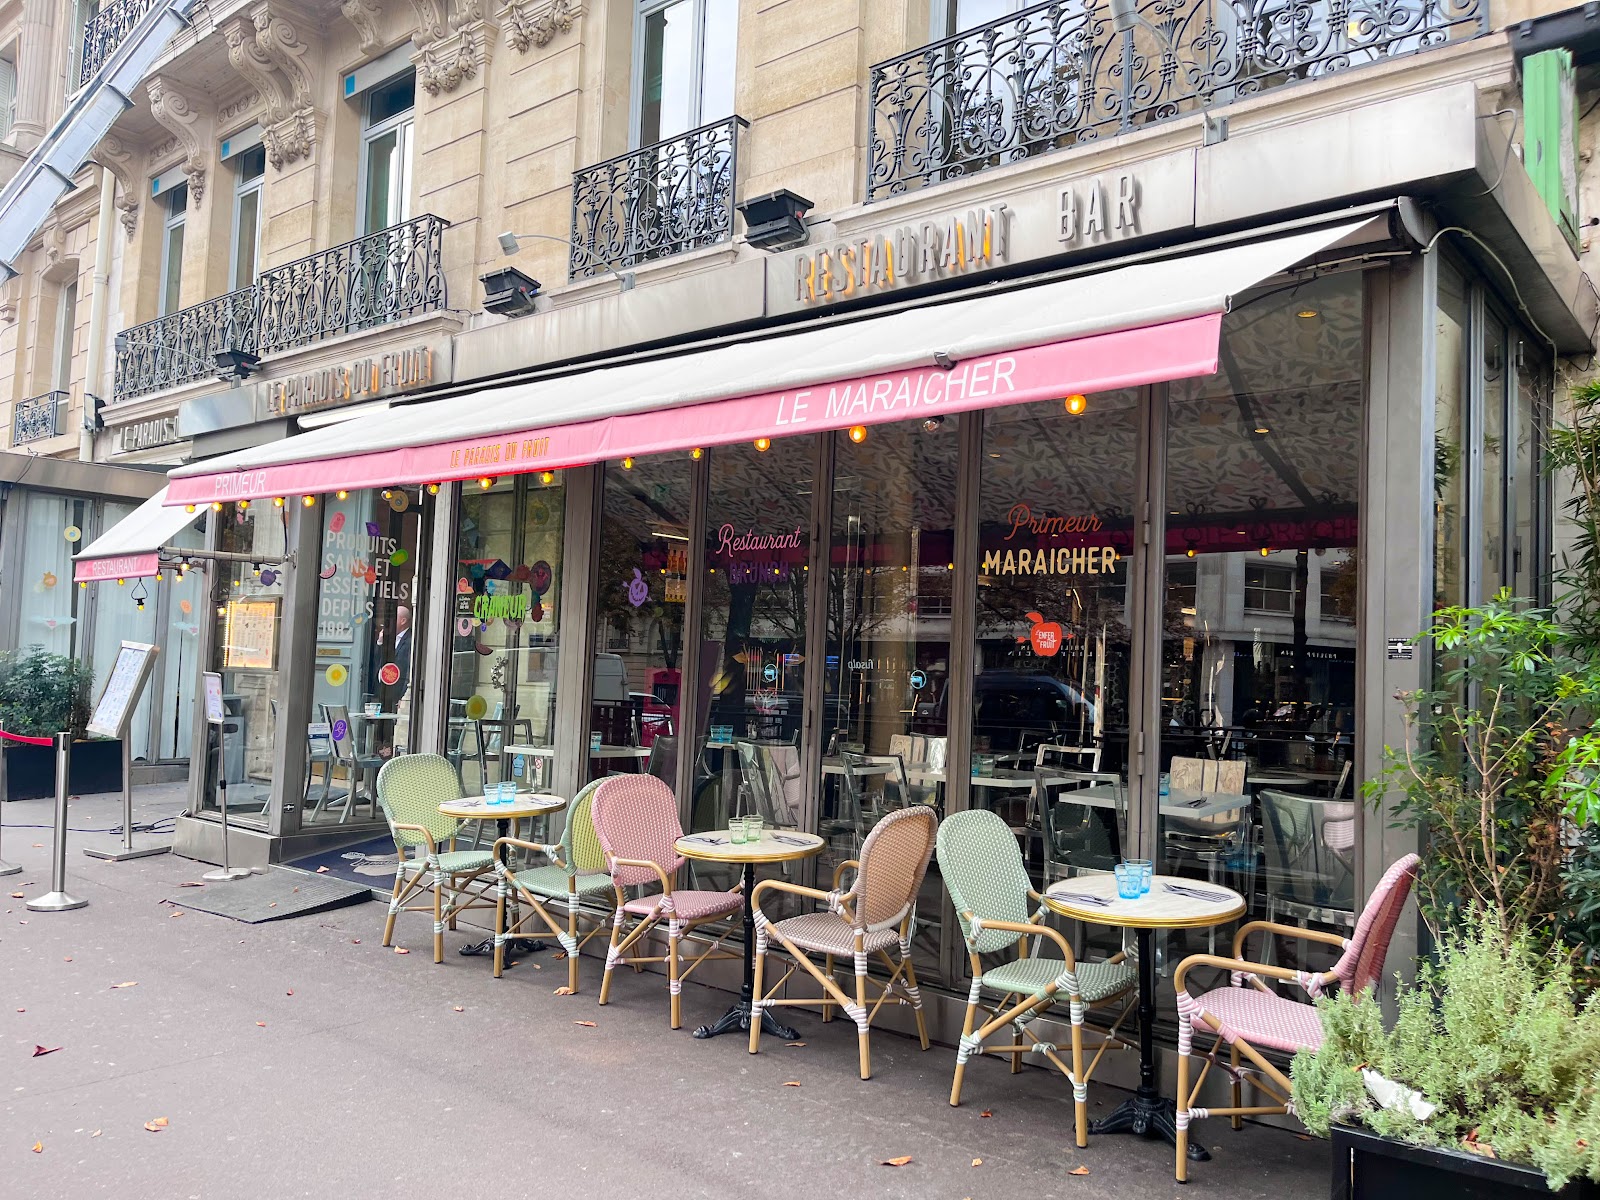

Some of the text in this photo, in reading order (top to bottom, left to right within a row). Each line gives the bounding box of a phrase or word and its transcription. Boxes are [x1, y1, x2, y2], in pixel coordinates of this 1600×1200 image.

[794, 172, 1138, 302] RESTAURANT BAR
[266, 345, 432, 413] LE PARADIS DU FRUIT
[775, 357, 1017, 426] LE MARAICHER
[120, 426, 131, 450] LE
[132, 417, 169, 448] PARADIS
[450, 437, 550, 468] LE PARADIS DU FRUIT
[215, 471, 266, 497] PRIMEUR
[1004, 503, 1103, 540] Primeur
[326, 530, 397, 556] PRODUITS
[715, 523, 801, 557] Restaurant
[92, 556, 139, 576] RESTAURANT
[324, 553, 369, 575] SAINS
[375, 557, 392, 577] ET
[729, 560, 789, 585] BRUNCH
[984, 546, 1116, 576] MARAICHER
[323, 576, 409, 600] ESSENTIELS
[1039, 640, 1055, 649] FRUIT
